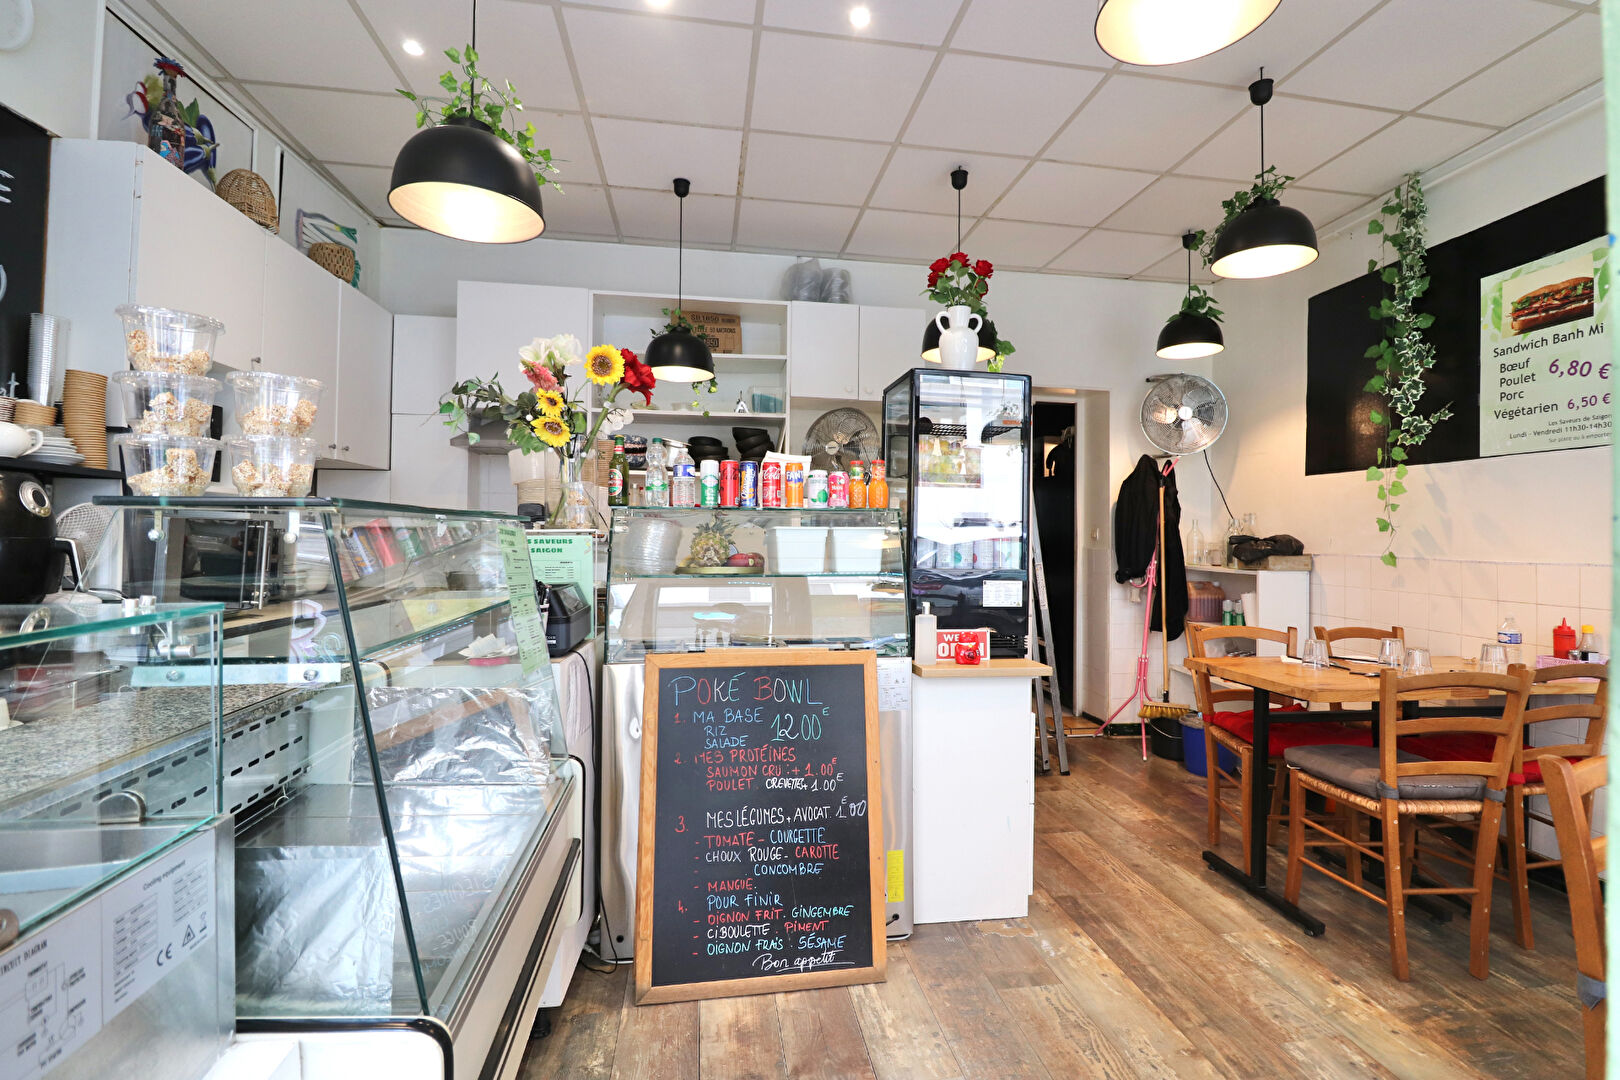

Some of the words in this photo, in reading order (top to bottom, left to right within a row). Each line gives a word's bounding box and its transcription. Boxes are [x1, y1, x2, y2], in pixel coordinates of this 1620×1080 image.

[1493, 337, 1548, 358] Sandwich
[1552, 328, 1584, 345] Banh
[1588, 322, 1605, 337] Mi
[1500, 357, 1531, 374] Bœuf
[1548, 358, 1593, 378] 6,80
[1598, 363, 1612, 380] €
[1500, 372, 1537, 388] Poulet
[1500, 390, 1525, 402] Porc
[1494, 403, 1559, 421] Végétarien
[1567, 395, 1598, 411] 6,50
[1602, 392, 1611, 404] €
[1533, 426, 1563, 437] Vendredi
[943, 633, 960, 642] WE
[667, 671, 746, 706] POKÉ
[753, 676, 823, 704] BOWL
[693, 711, 715, 723] MA
[724, 707, 764, 723] BASE
[704, 725, 727, 737] RIZ
[704, 735, 749, 749] SALADE
[694, 750, 724, 764] MES
[705, 764, 758, 779] SAUMON
[762, 764, 782, 777] CRU
[705, 777, 755, 792] POULET
[706, 811, 734, 828] MES
[736, 805, 785, 827] LÉGUMES
[703, 831, 755, 849] TOMATE
[769, 827, 826, 844] COURGETTE
[705, 850, 742, 863] CHOUX
[747, 846, 784, 862] ROUGE
[795, 843, 840, 860] CAROTTE
[753, 862, 825, 876] CONCOMBRE
[706, 894, 740, 911] POUR
[797, 932, 847, 950] SÉSAME
[752, 953, 789, 971] Bon
